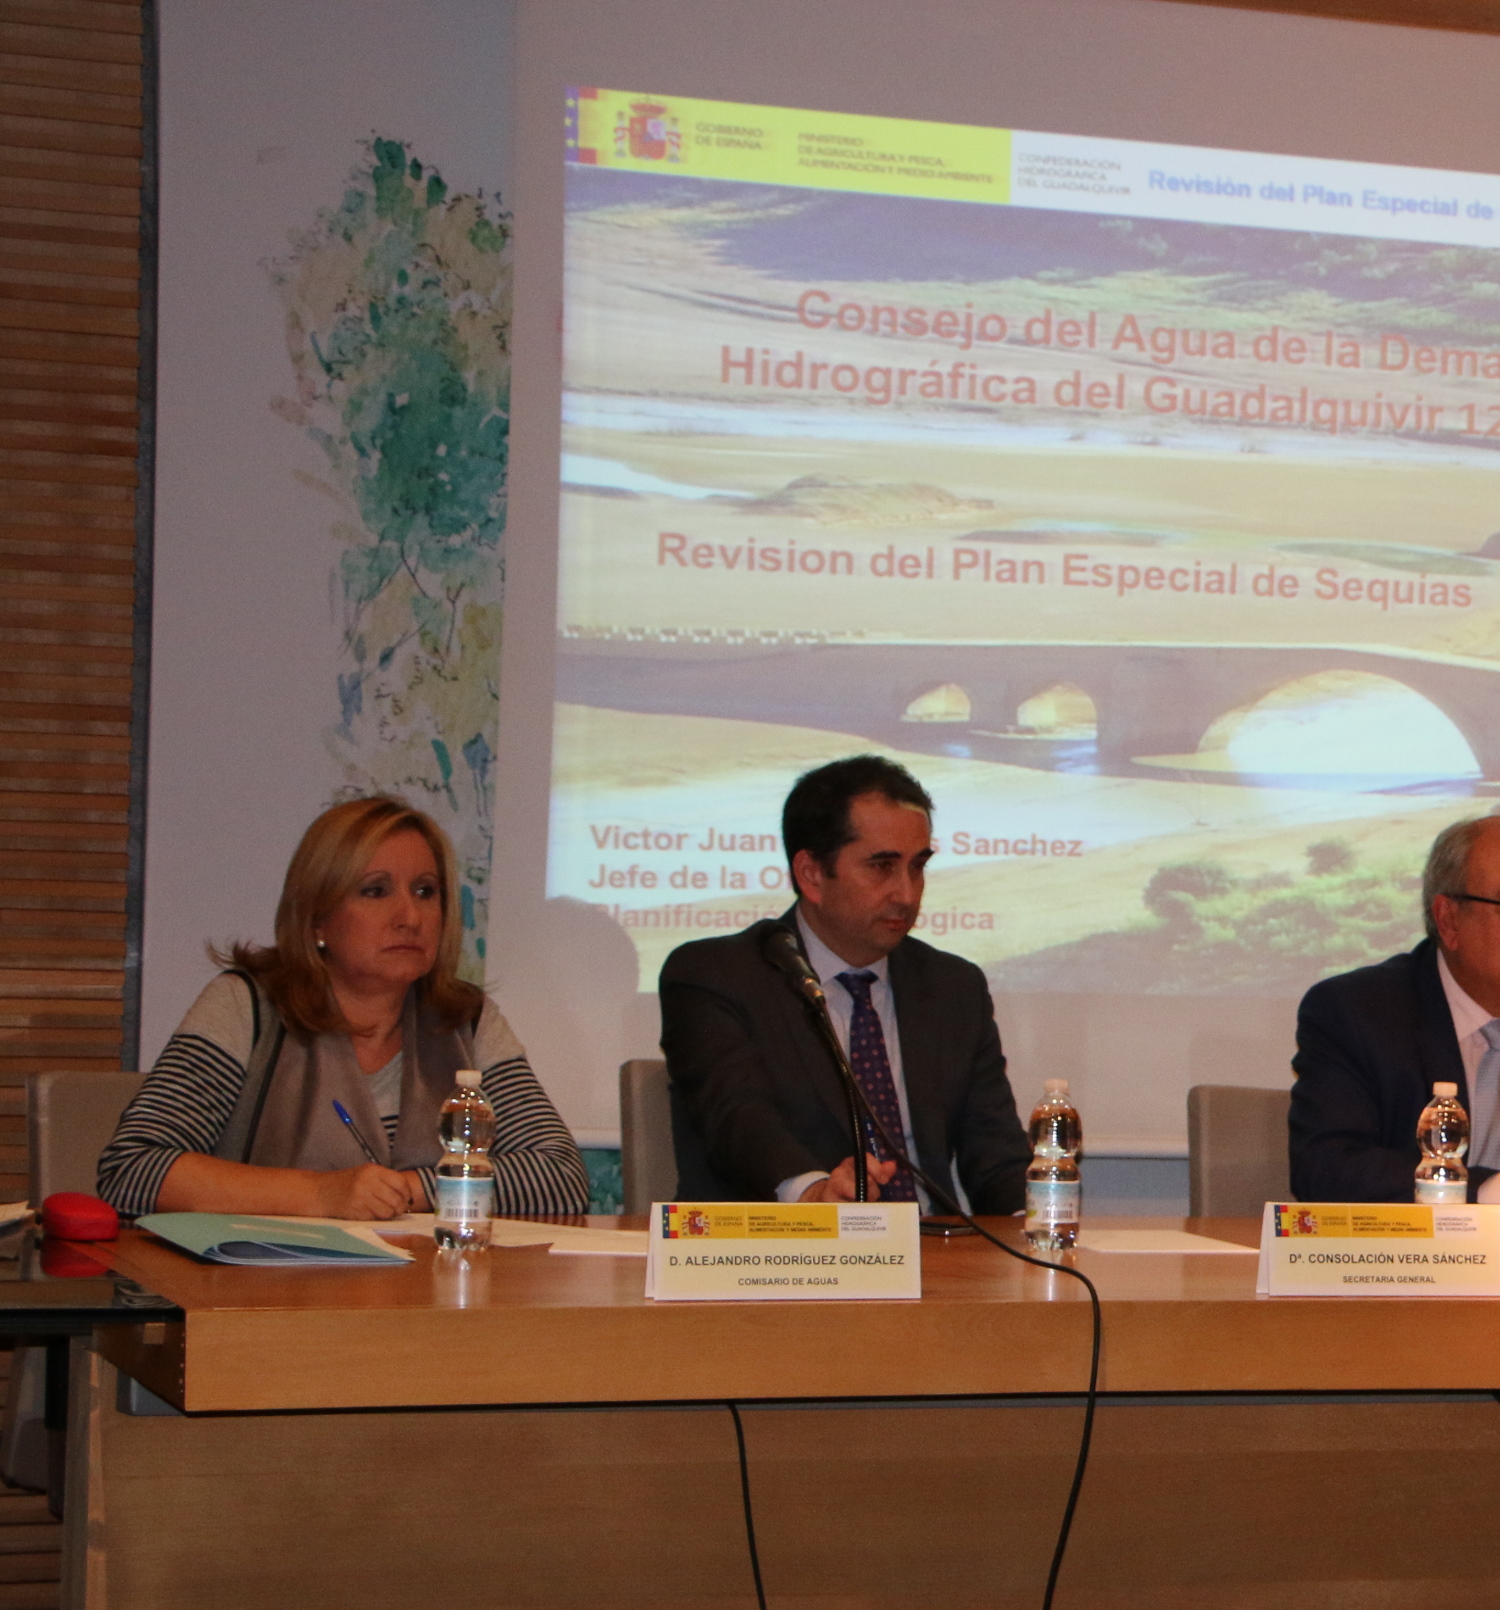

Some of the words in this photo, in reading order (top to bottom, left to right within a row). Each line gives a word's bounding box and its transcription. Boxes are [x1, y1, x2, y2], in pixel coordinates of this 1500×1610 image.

[1148, 169, 1250, 199] Revisión
[1259, 180, 1295, 203] del
[1303, 184, 1352, 208] Plan
[1362, 189, 1458, 216] Especial
[1466, 200, 1493, 220] de
[797, 289, 1007, 350] Consejo
[1023, 309, 1096, 348] del
[1112, 313, 1235, 364] Agua
[1252, 325, 1308, 365] de
[1324, 330, 1361, 370] la
[720, 344, 1037, 405] Hidrográfica
[1053, 370, 1126, 410] del
[1143, 376, 1445, 435] Guadalquivir
[656, 531, 853, 576] Revision
[870, 544, 935, 579] del
[953, 547, 1046, 585] Plan
[1063, 553, 1237, 597] Especial
[1252, 565, 1299, 598] de
[1315, 568, 1472, 612] Sequias
[590, 825, 689, 851] Victor
[698, 827, 777, 852] Juan
[952, 831, 1083, 857] Sanchez
[588, 864, 657, 889] Jefe
[669, 865, 708, 890] de
[720, 865, 747, 890] la
[669, 1256, 681, 1266] D.
[685, 1255, 761, 1266] ALEJANDRO
[764, 1253, 837, 1266] RODRÍGUEZ
[839, 1253, 905, 1265] GONZÁLEZ
[1308, 1251, 1394, 1264] CONSOLACIÓN
[1397, 1254, 1429, 1264] VERA
[1432, 1252, 1487, 1265] SÁNCHEZ
[738, 1278, 790, 1286] COMISARIO
[792, 1277, 804, 1285] DE
[806, 1277, 838, 1285] AGUAS
[1342, 1275, 1395, 1283] SECRETARIA
[1396, 1275, 1436, 1283] GENERAL
